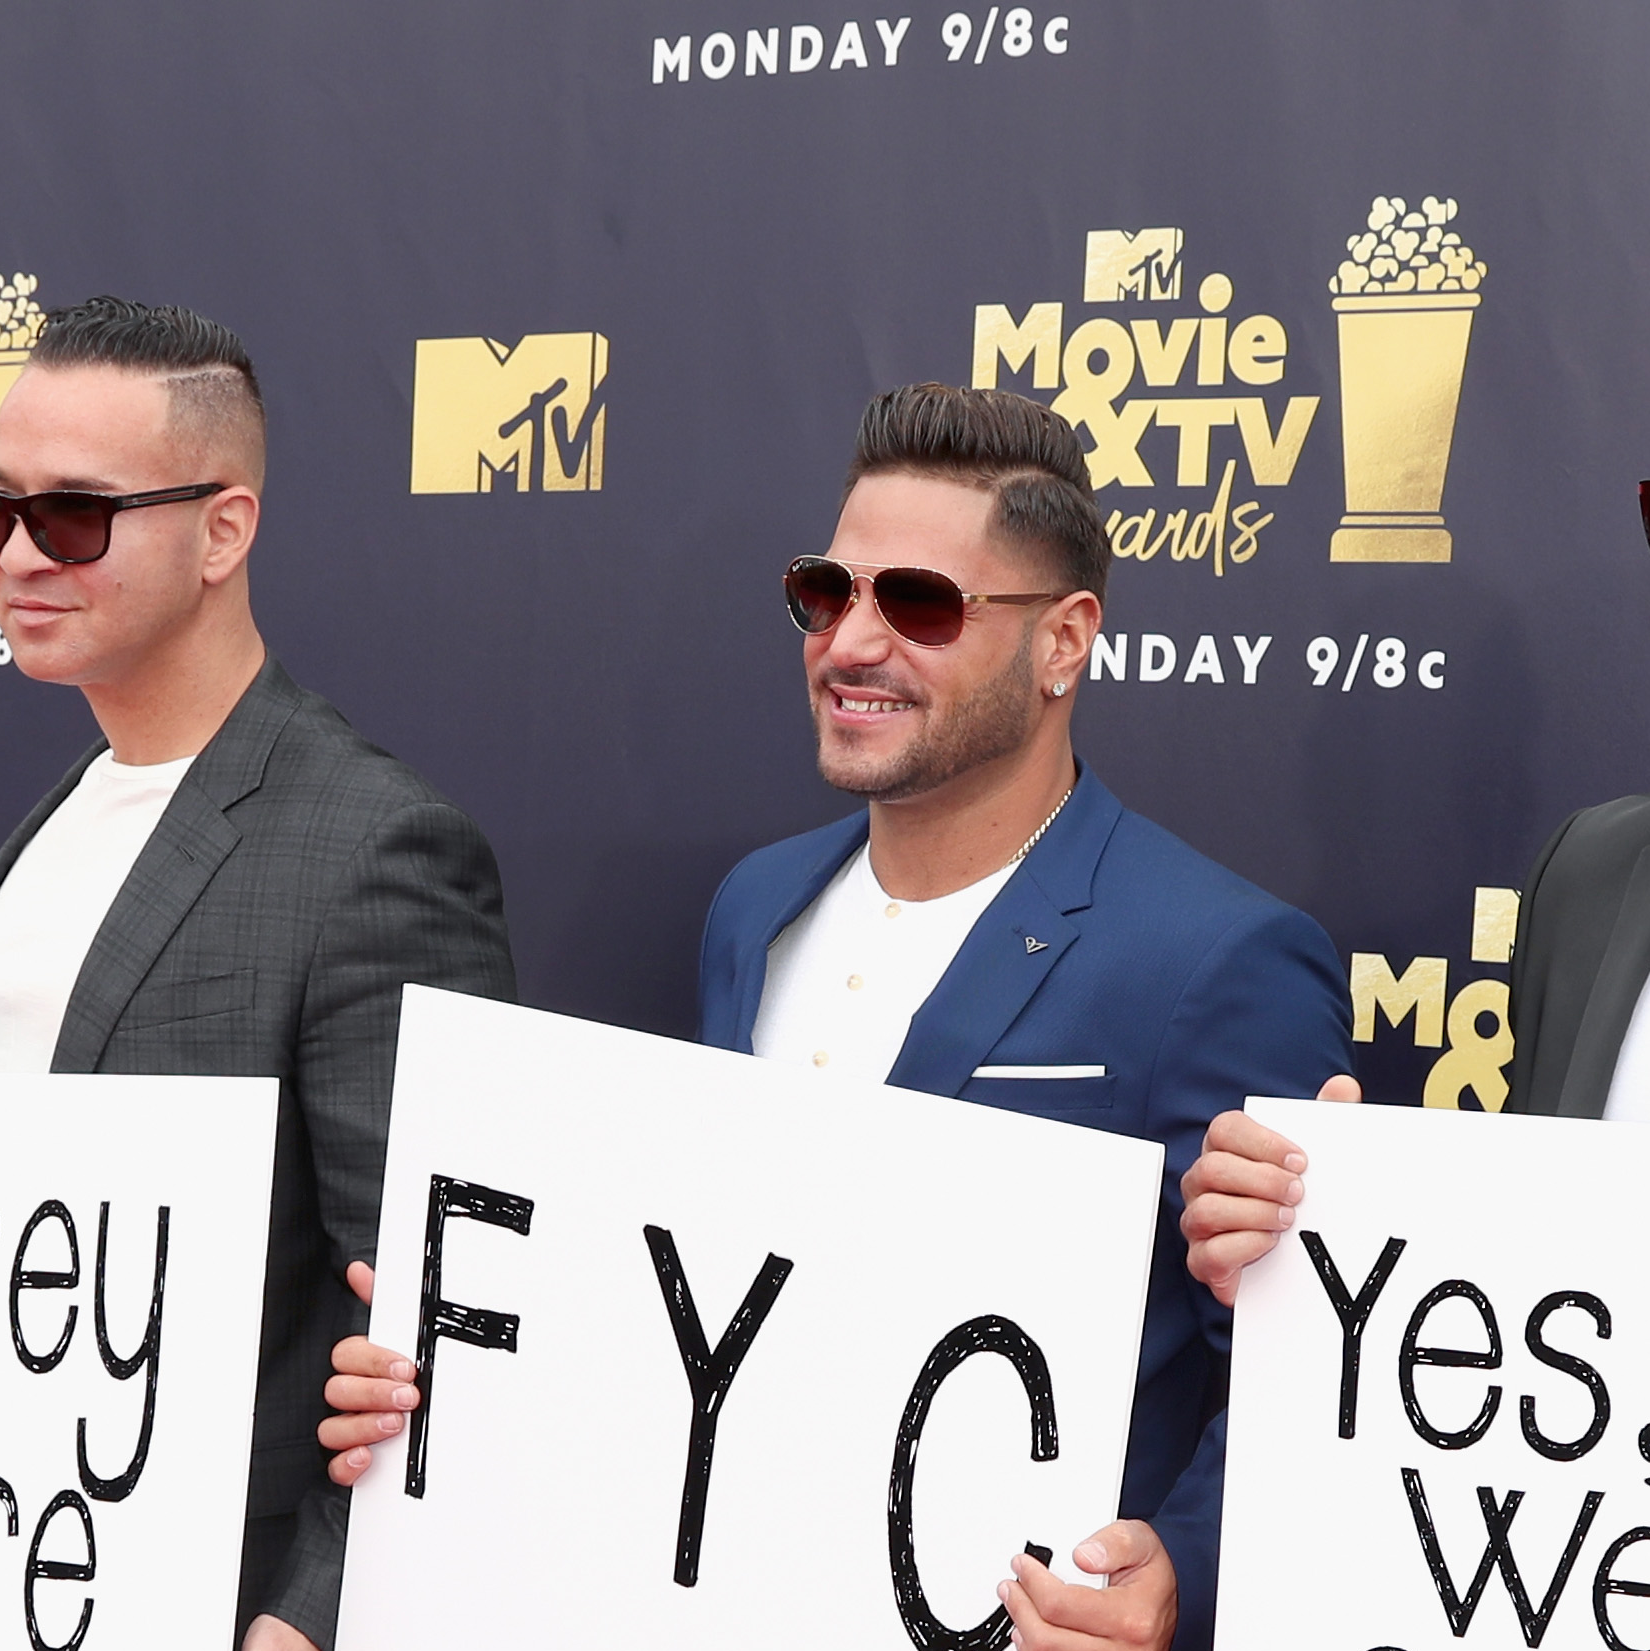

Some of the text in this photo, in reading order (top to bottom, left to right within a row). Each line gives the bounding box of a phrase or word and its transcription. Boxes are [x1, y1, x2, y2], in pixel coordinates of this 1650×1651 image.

[652, 6, 1070, 84] MONDAY 9/8c
[1083, 226, 1184, 302] MTV
[971, 272, 1288, 392] Movie
[411, 331, 609, 495] MTV
[1106, 458, 1276, 579] ards
[1090, 631, 1447, 693] NDAY 9/8c
